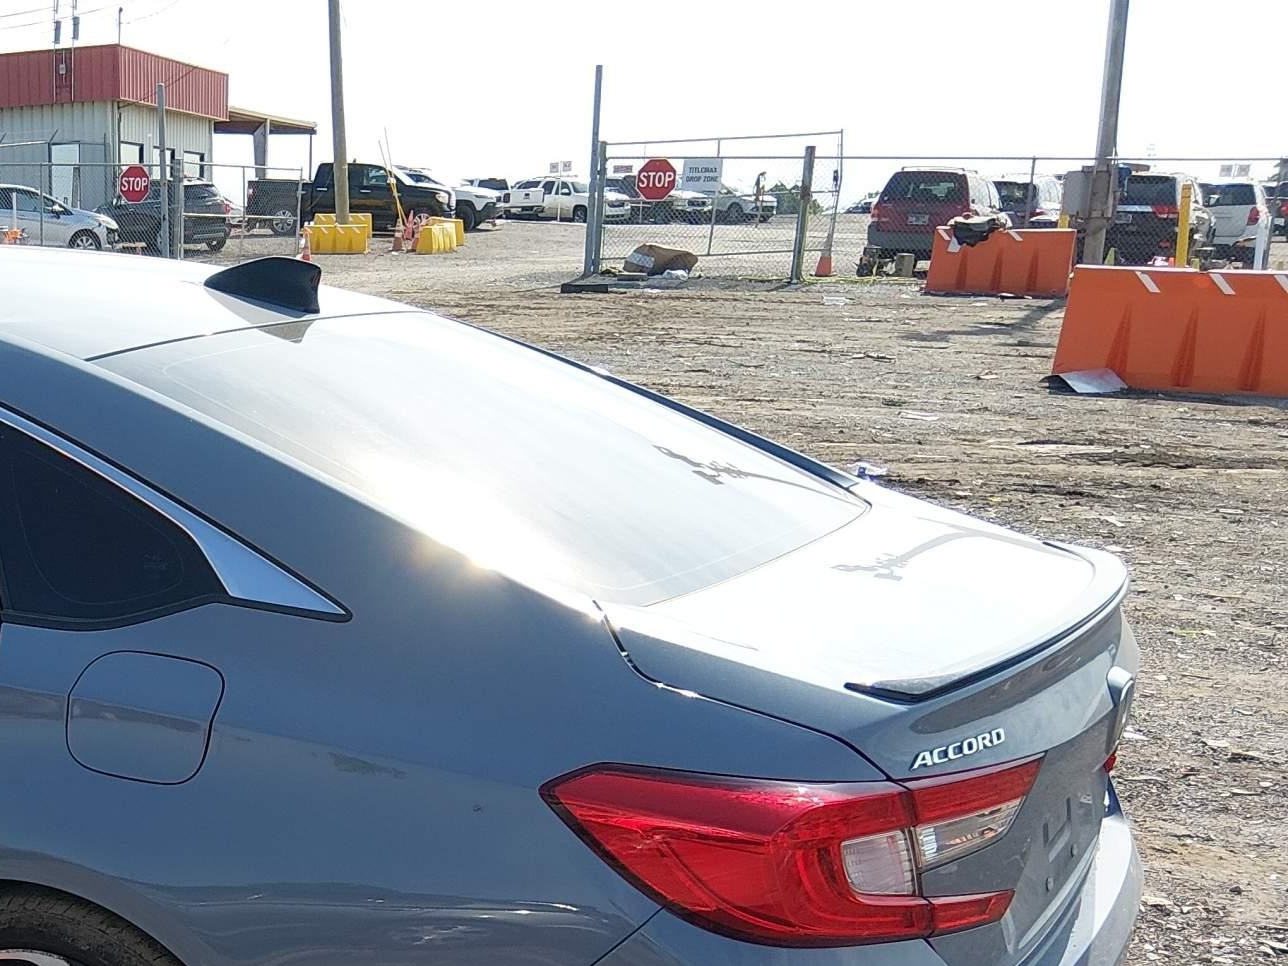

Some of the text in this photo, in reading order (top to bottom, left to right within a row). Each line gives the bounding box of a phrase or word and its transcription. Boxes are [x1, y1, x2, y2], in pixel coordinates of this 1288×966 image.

[121, 177, 148, 191] STOP
[638, 171, 674, 188] STOP
[910, 728, 1006, 770] ACCORD
